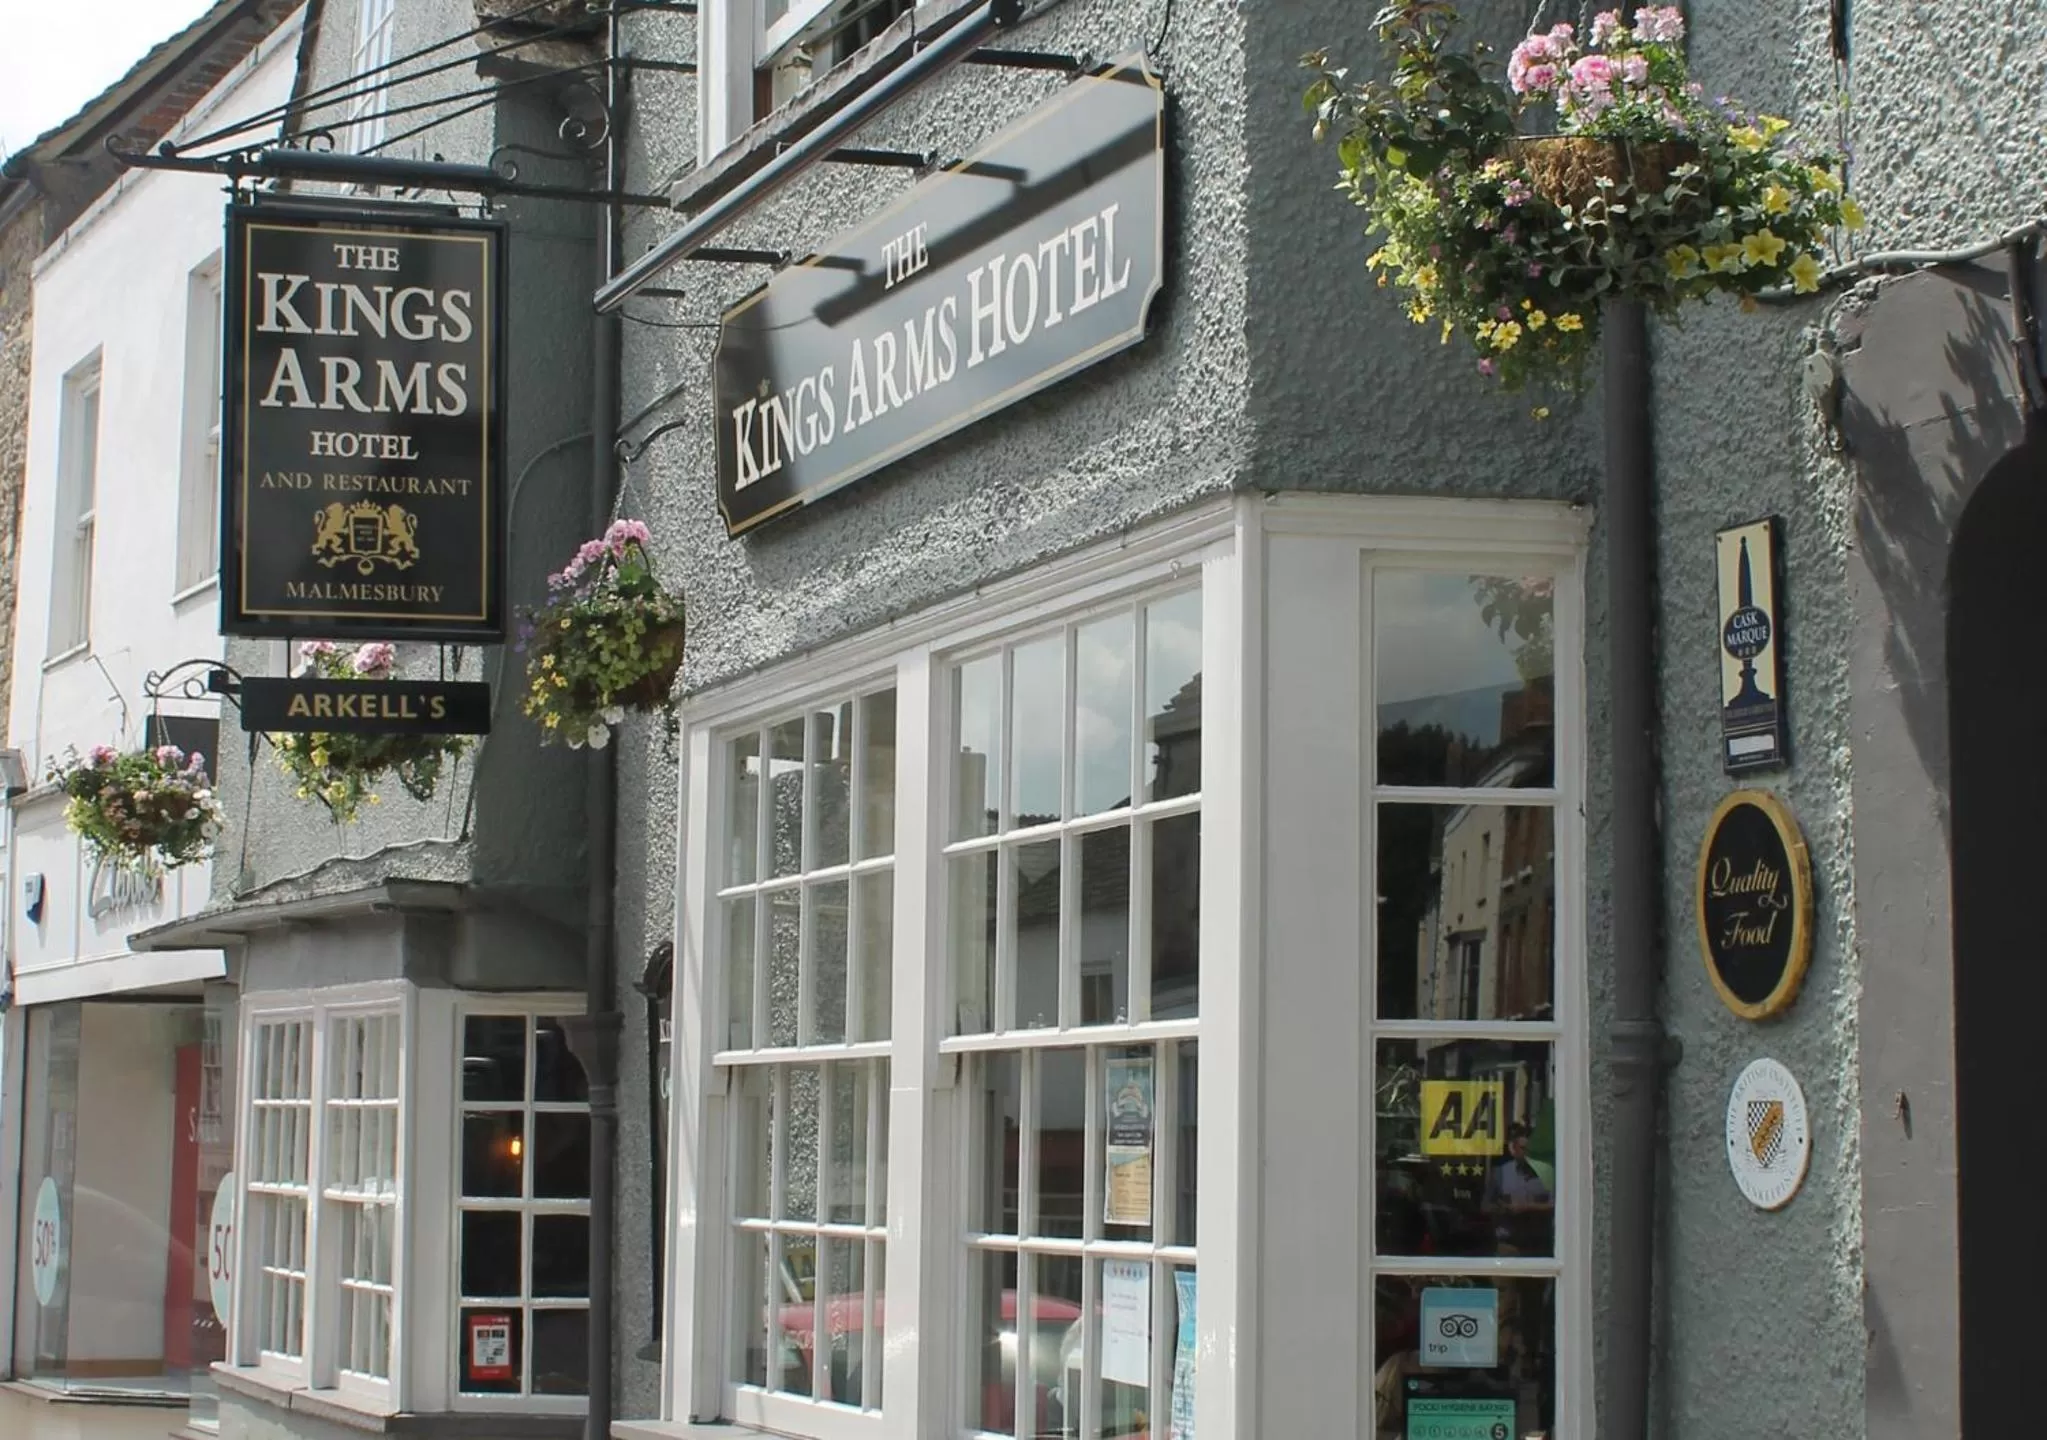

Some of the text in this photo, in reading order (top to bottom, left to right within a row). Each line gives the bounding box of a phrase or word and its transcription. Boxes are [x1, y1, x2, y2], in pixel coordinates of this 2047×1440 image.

[333, 243, 400, 272] THE
[881, 221, 928, 290] THE
[257, 272, 472, 343] KINGS
[732, 202, 1132, 492] KINGS ARMS HOTEL
[260, 347, 467, 417] ARMS
[310, 431, 418, 460] HOTEL
[260, 471, 472, 496] AND RESTAURANT
[286, 581, 444, 603] MALMESBURY
[1733, 611, 1759, 629] CASK
[1727, 625, 1767, 645] MARQUE
[287, 693, 446, 719] ARKELL'S
[1709, 857, 1786, 908] Quality
[1721, 910, 1778, 950] Food
[1428, 1090, 1498, 1140] AA
[1494, 1425, 1505, 1439] 5
